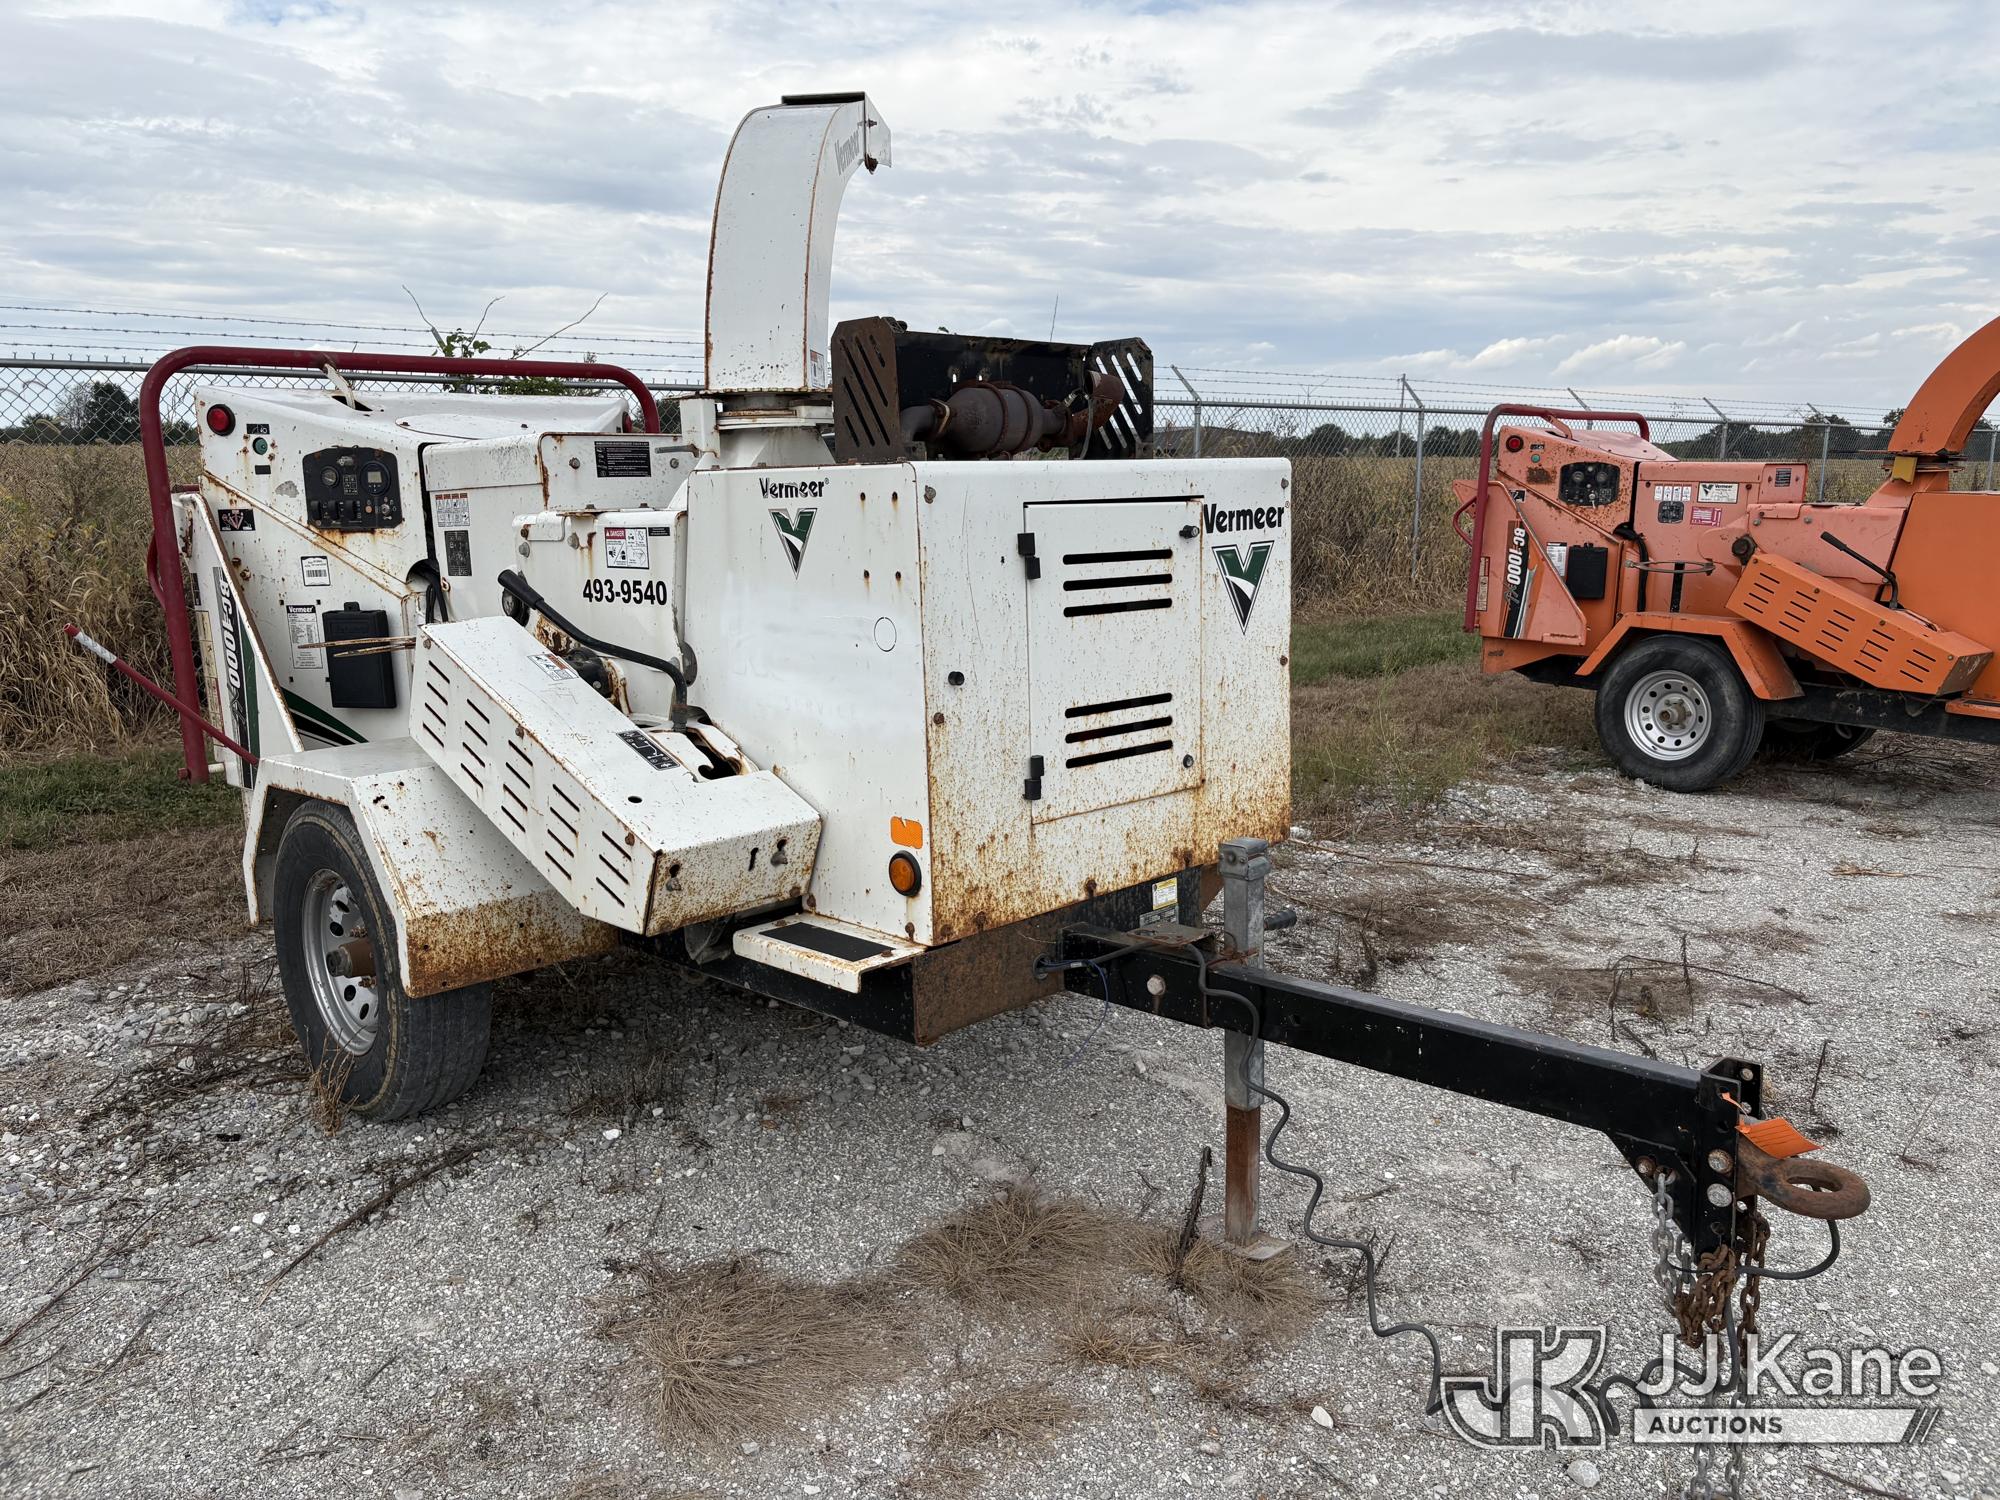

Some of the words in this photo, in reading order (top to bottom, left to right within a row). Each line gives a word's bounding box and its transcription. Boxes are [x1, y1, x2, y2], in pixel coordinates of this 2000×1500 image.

[759, 477, 824, 499] Vermeer
[1203, 503, 1285, 534] Vermeer
[582, 578, 668, 606] 493-9540
